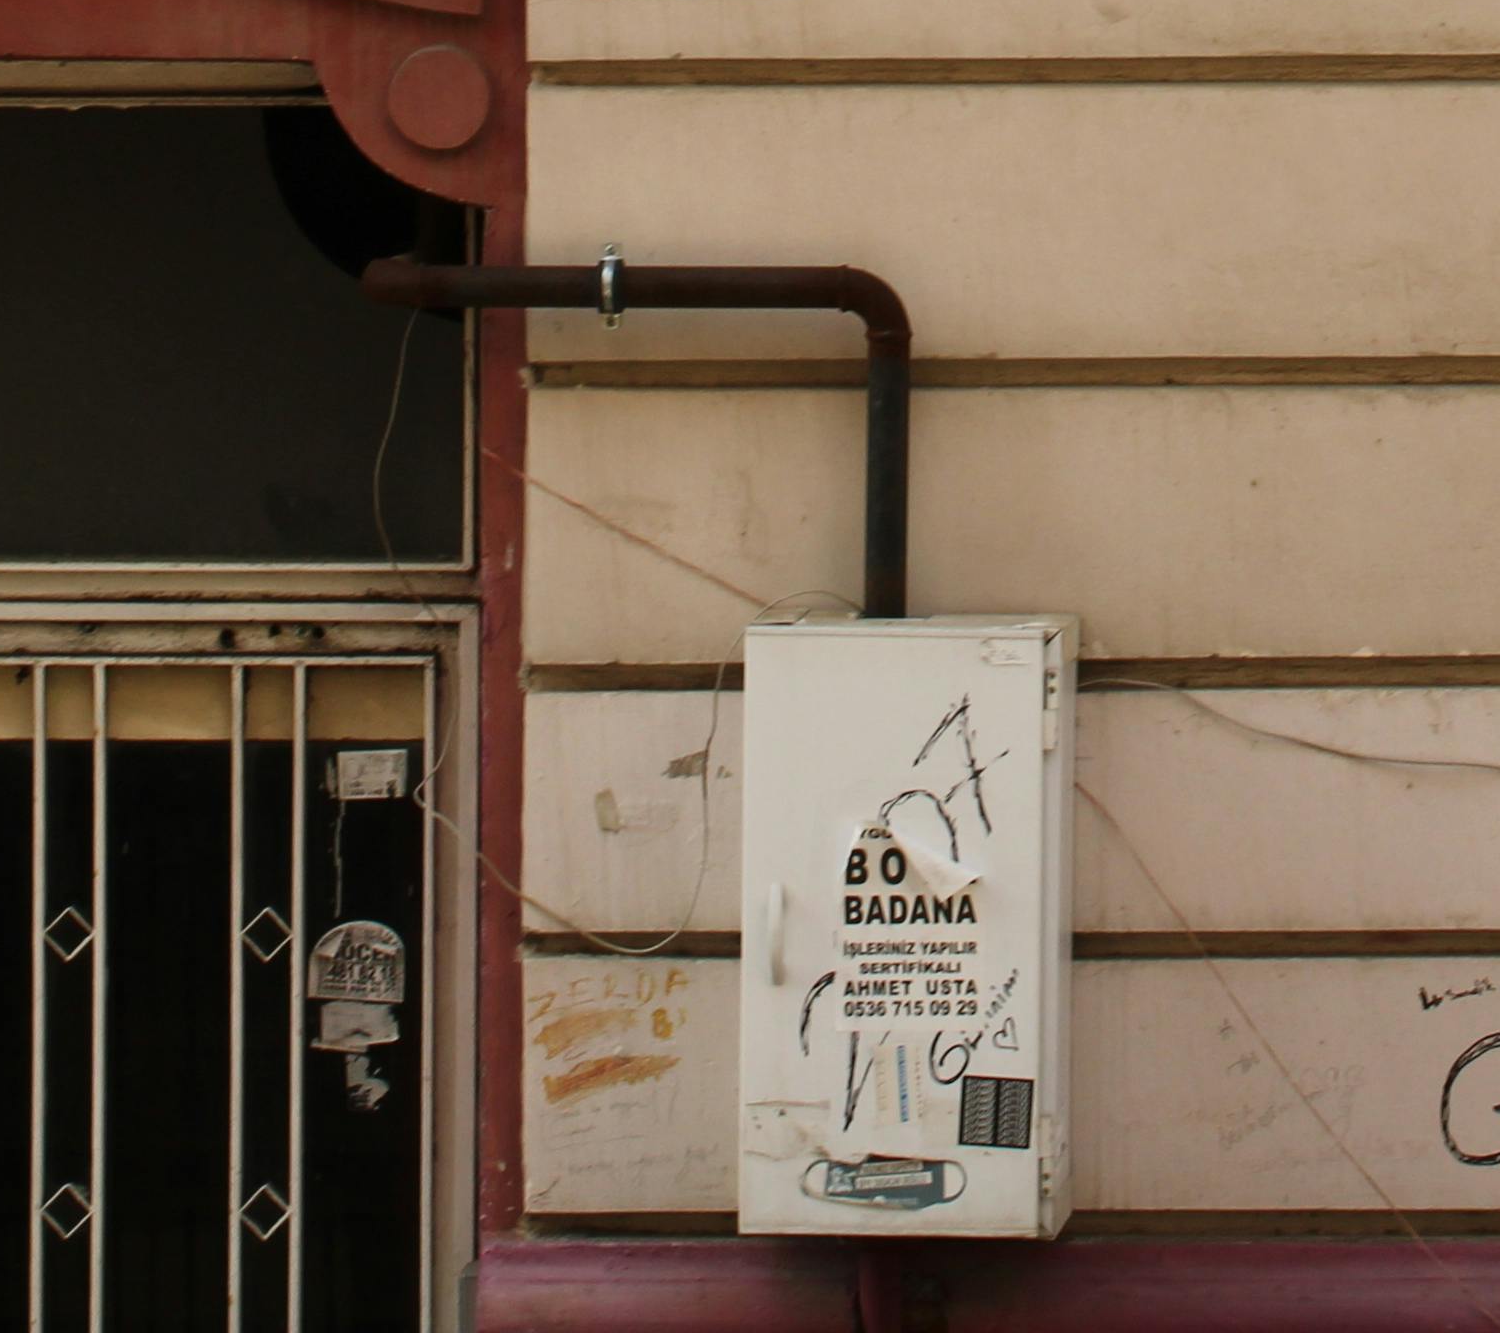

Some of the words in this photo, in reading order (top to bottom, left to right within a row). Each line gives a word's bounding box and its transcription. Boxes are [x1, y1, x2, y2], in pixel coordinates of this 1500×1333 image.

[844, 894, 978, 926] BADANA
[843, 939, 916, 959] İŞLERİNİZ
[920, 940, 978, 955] YAPILIR
[859, 959, 962, 975] SERTİFİKALI
[844, 979, 913, 996] AHMET
[924, 978, 978, 995] USTA
[843, 1000, 887, 1017] 0536
[890, 1000, 924, 1017] 715
[929, 1000, 952, 1017] 09
[955, 1000, 978, 1017] 29
